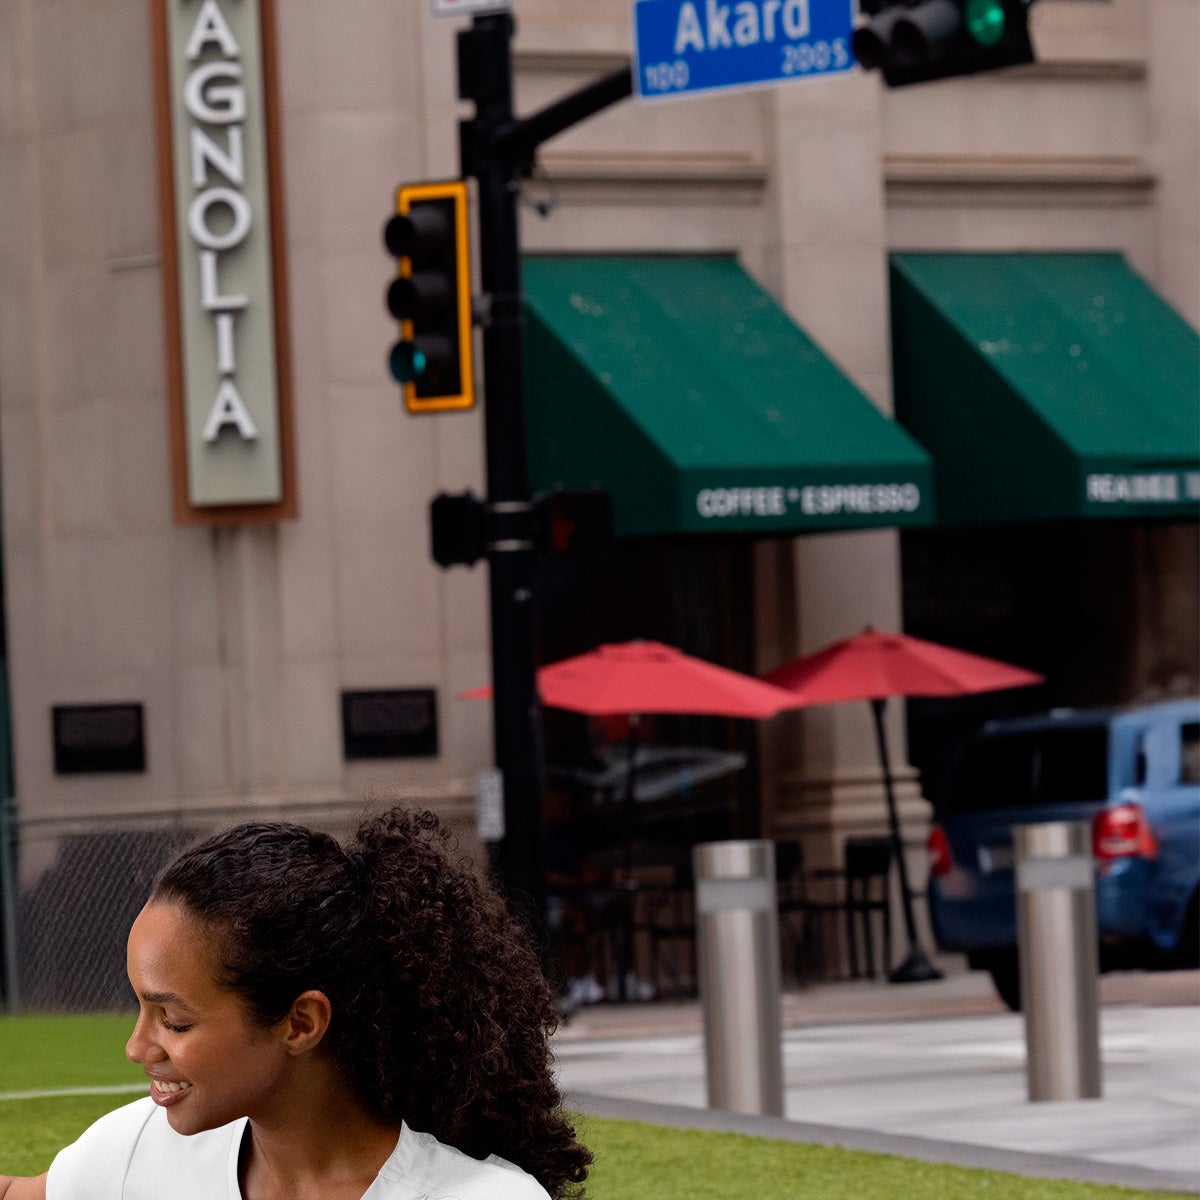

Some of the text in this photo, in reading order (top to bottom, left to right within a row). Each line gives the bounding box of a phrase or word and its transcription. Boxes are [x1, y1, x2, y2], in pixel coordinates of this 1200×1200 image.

[674, 0, 810, 54] Akard
[646, 61, 689, 91] 100
[183, 0, 258, 441] AGNOLIA
[697, 483, 920, 518] COFFEE ESPRESSO
